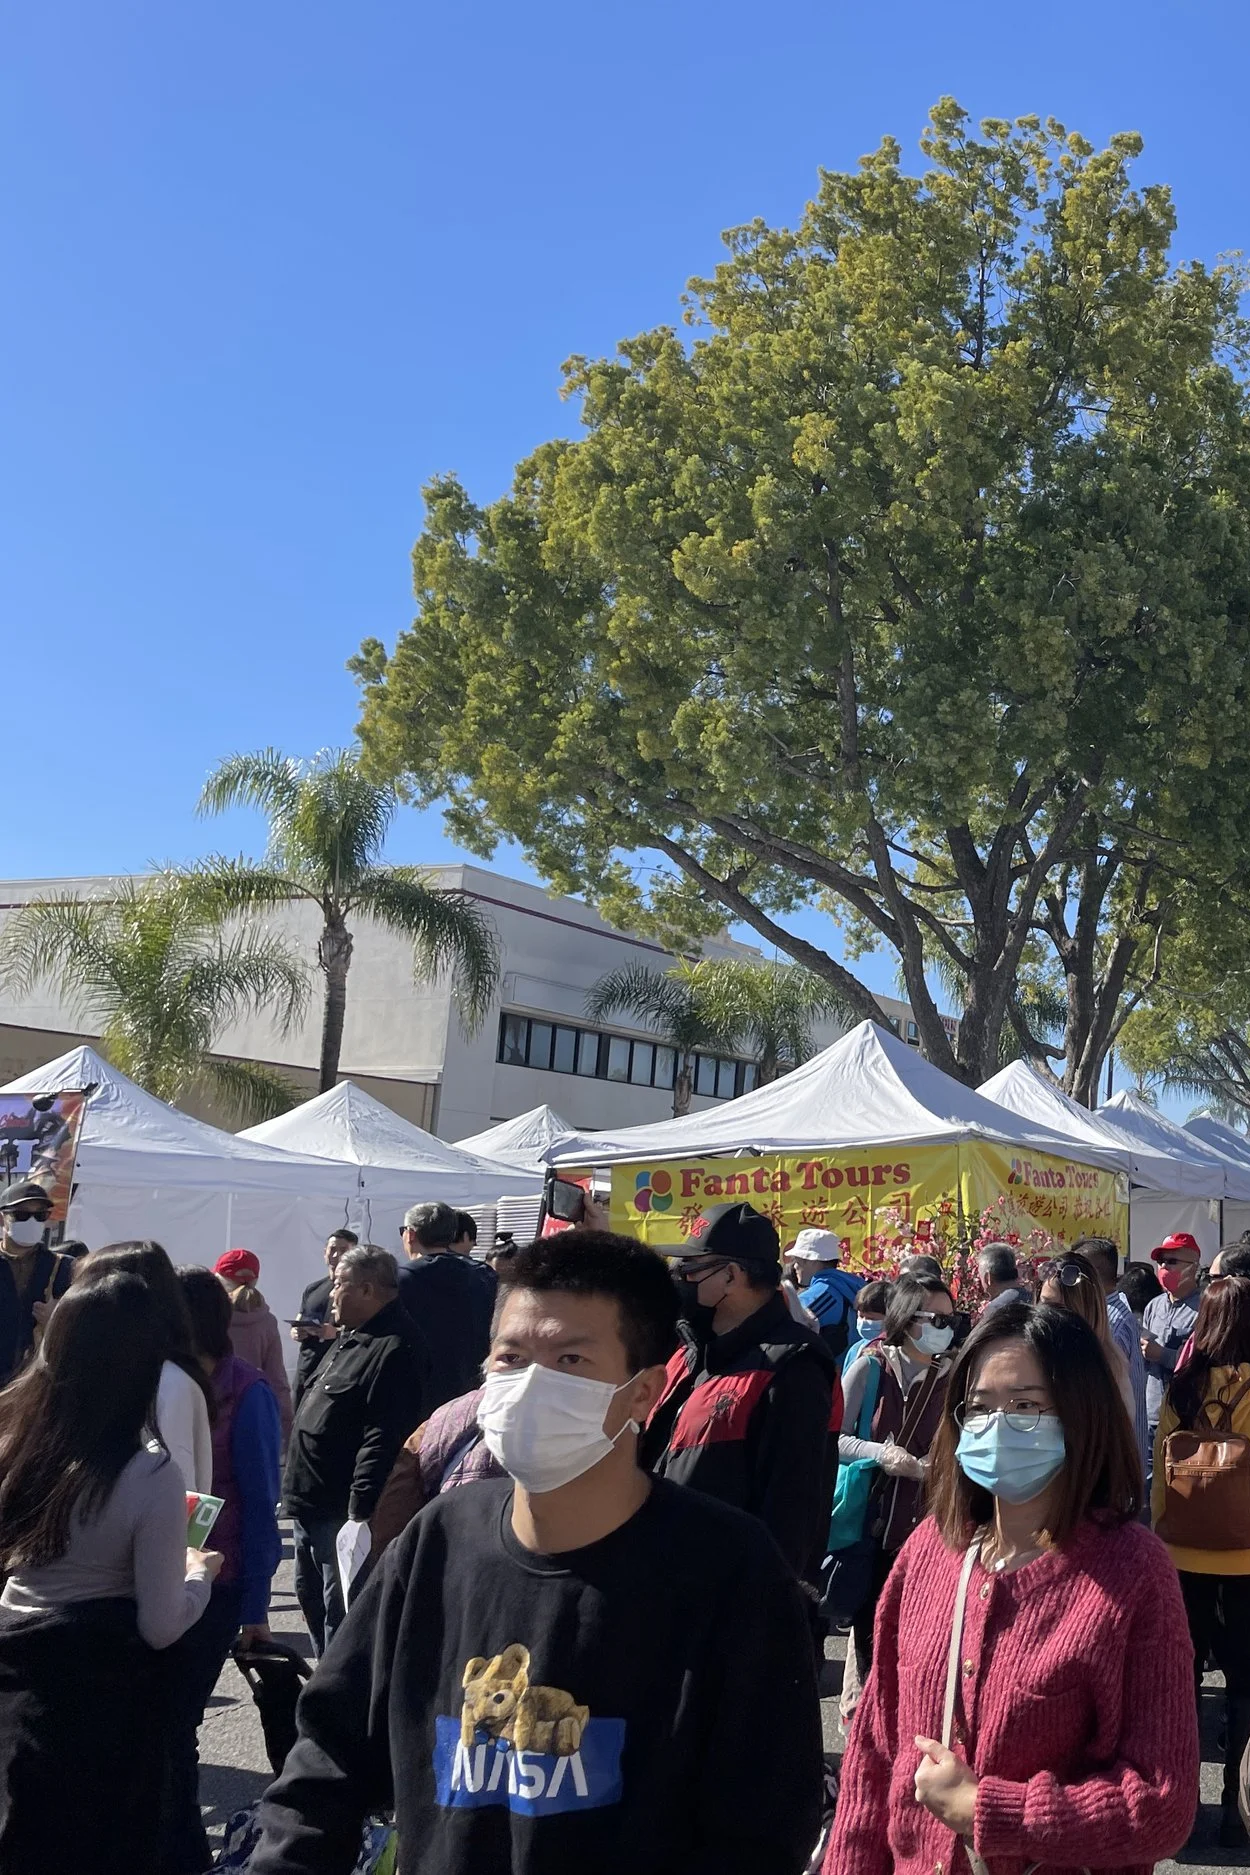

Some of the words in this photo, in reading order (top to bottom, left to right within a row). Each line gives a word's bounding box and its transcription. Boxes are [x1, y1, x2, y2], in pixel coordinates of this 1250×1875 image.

[680, 1167, 792, 1198] Fanta
[796, 1161, 911, 1190] Tours
[1023, 1161, 1066, 1189] Fanta
[1065, 1164, 1099, 1190] Tours
[451, 1738, 589, 1800] NASA
